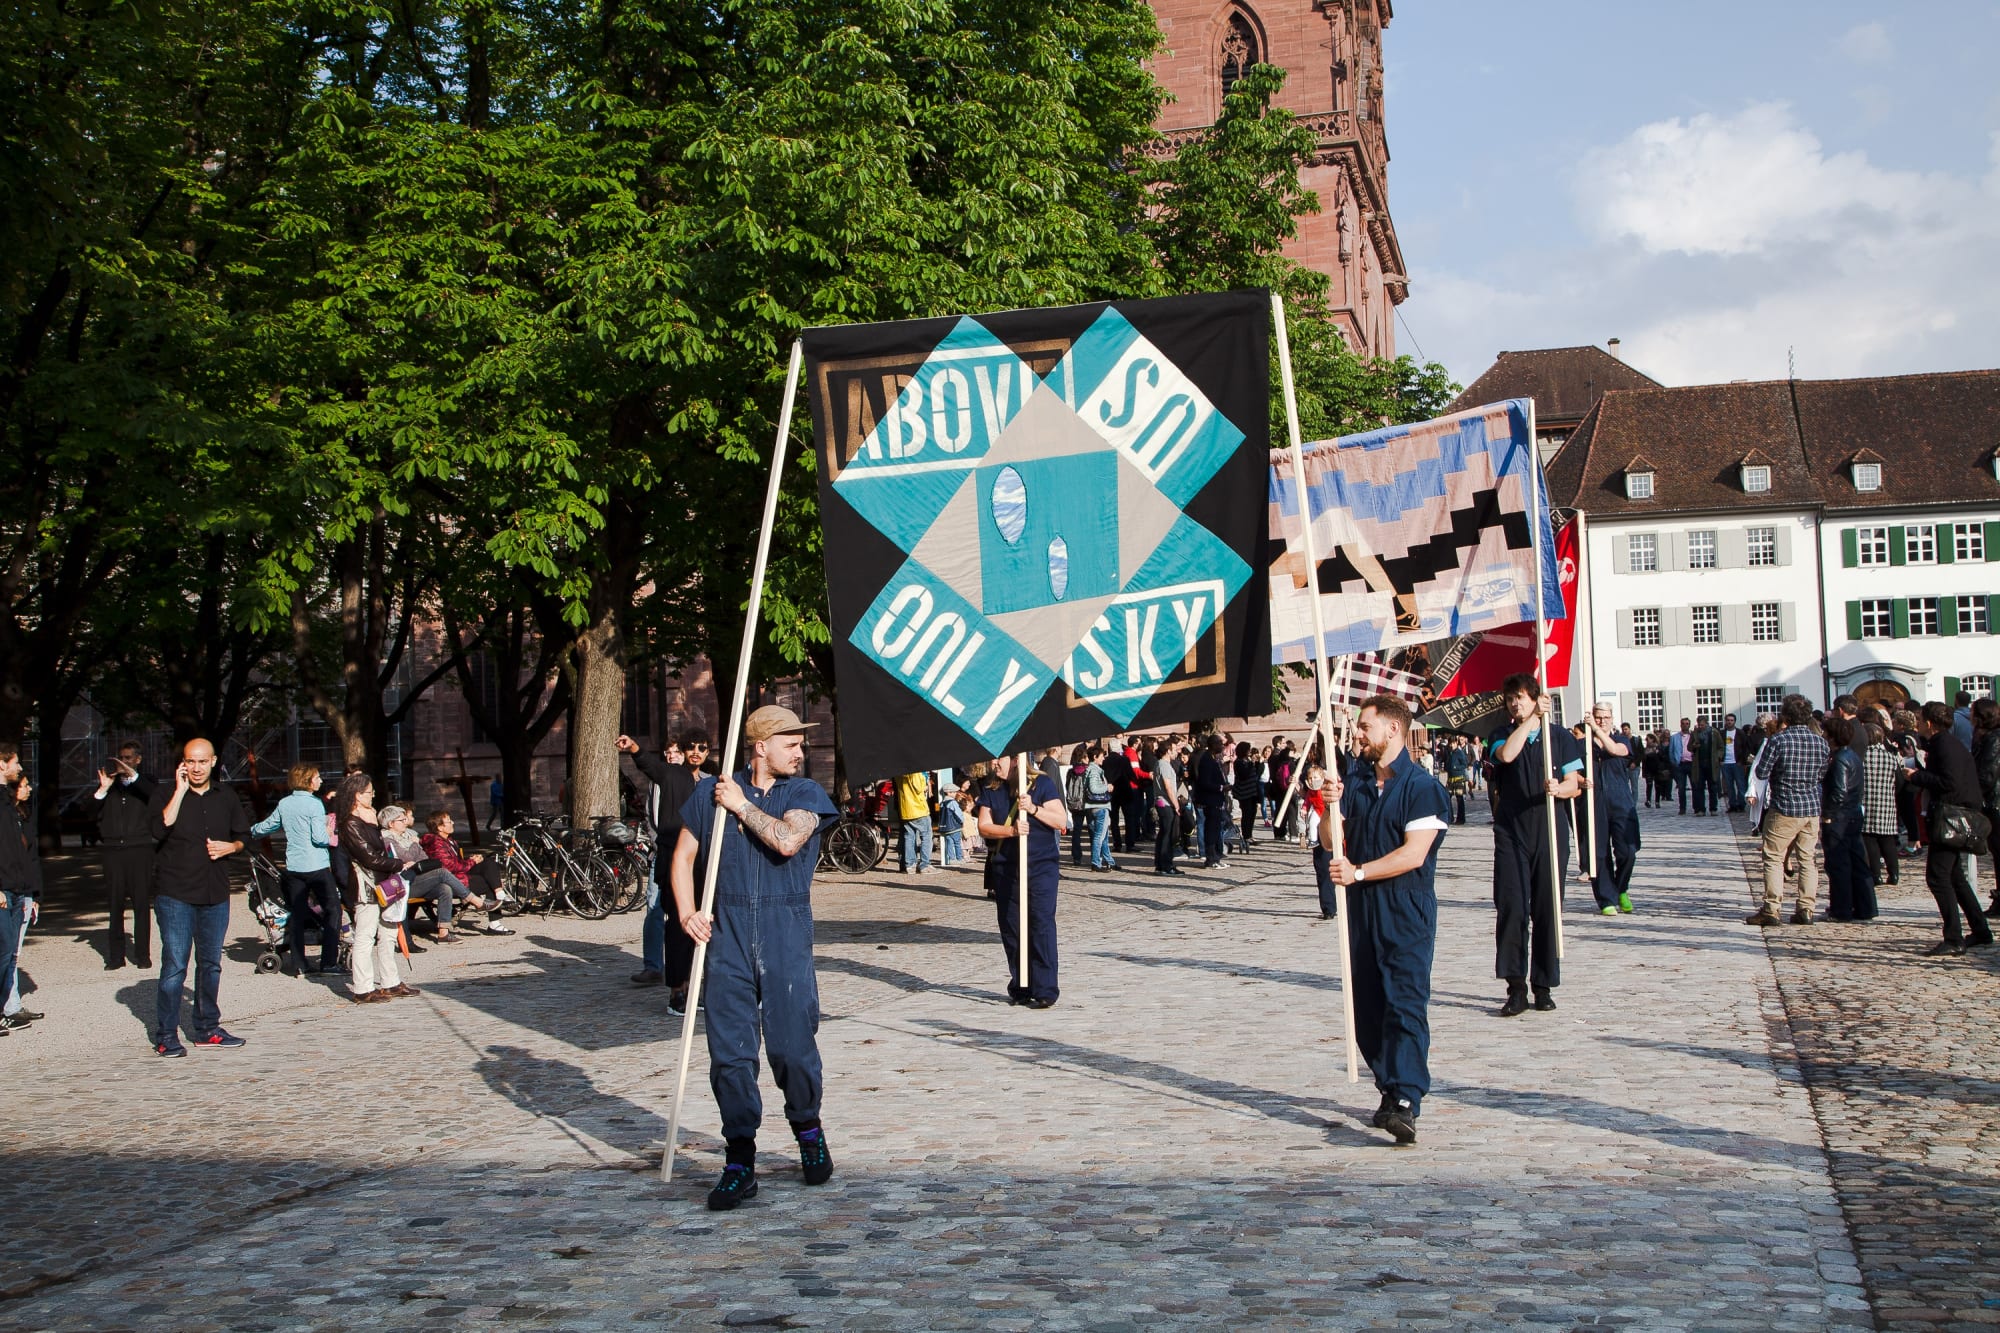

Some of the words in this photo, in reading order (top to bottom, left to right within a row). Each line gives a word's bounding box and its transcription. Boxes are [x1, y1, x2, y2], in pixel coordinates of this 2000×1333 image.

[872, 585, 1038, 736] ONLY
[1079, 597, 1207, 690] SKY
[1451, 693, 1505, 725] EXPRESSIO
